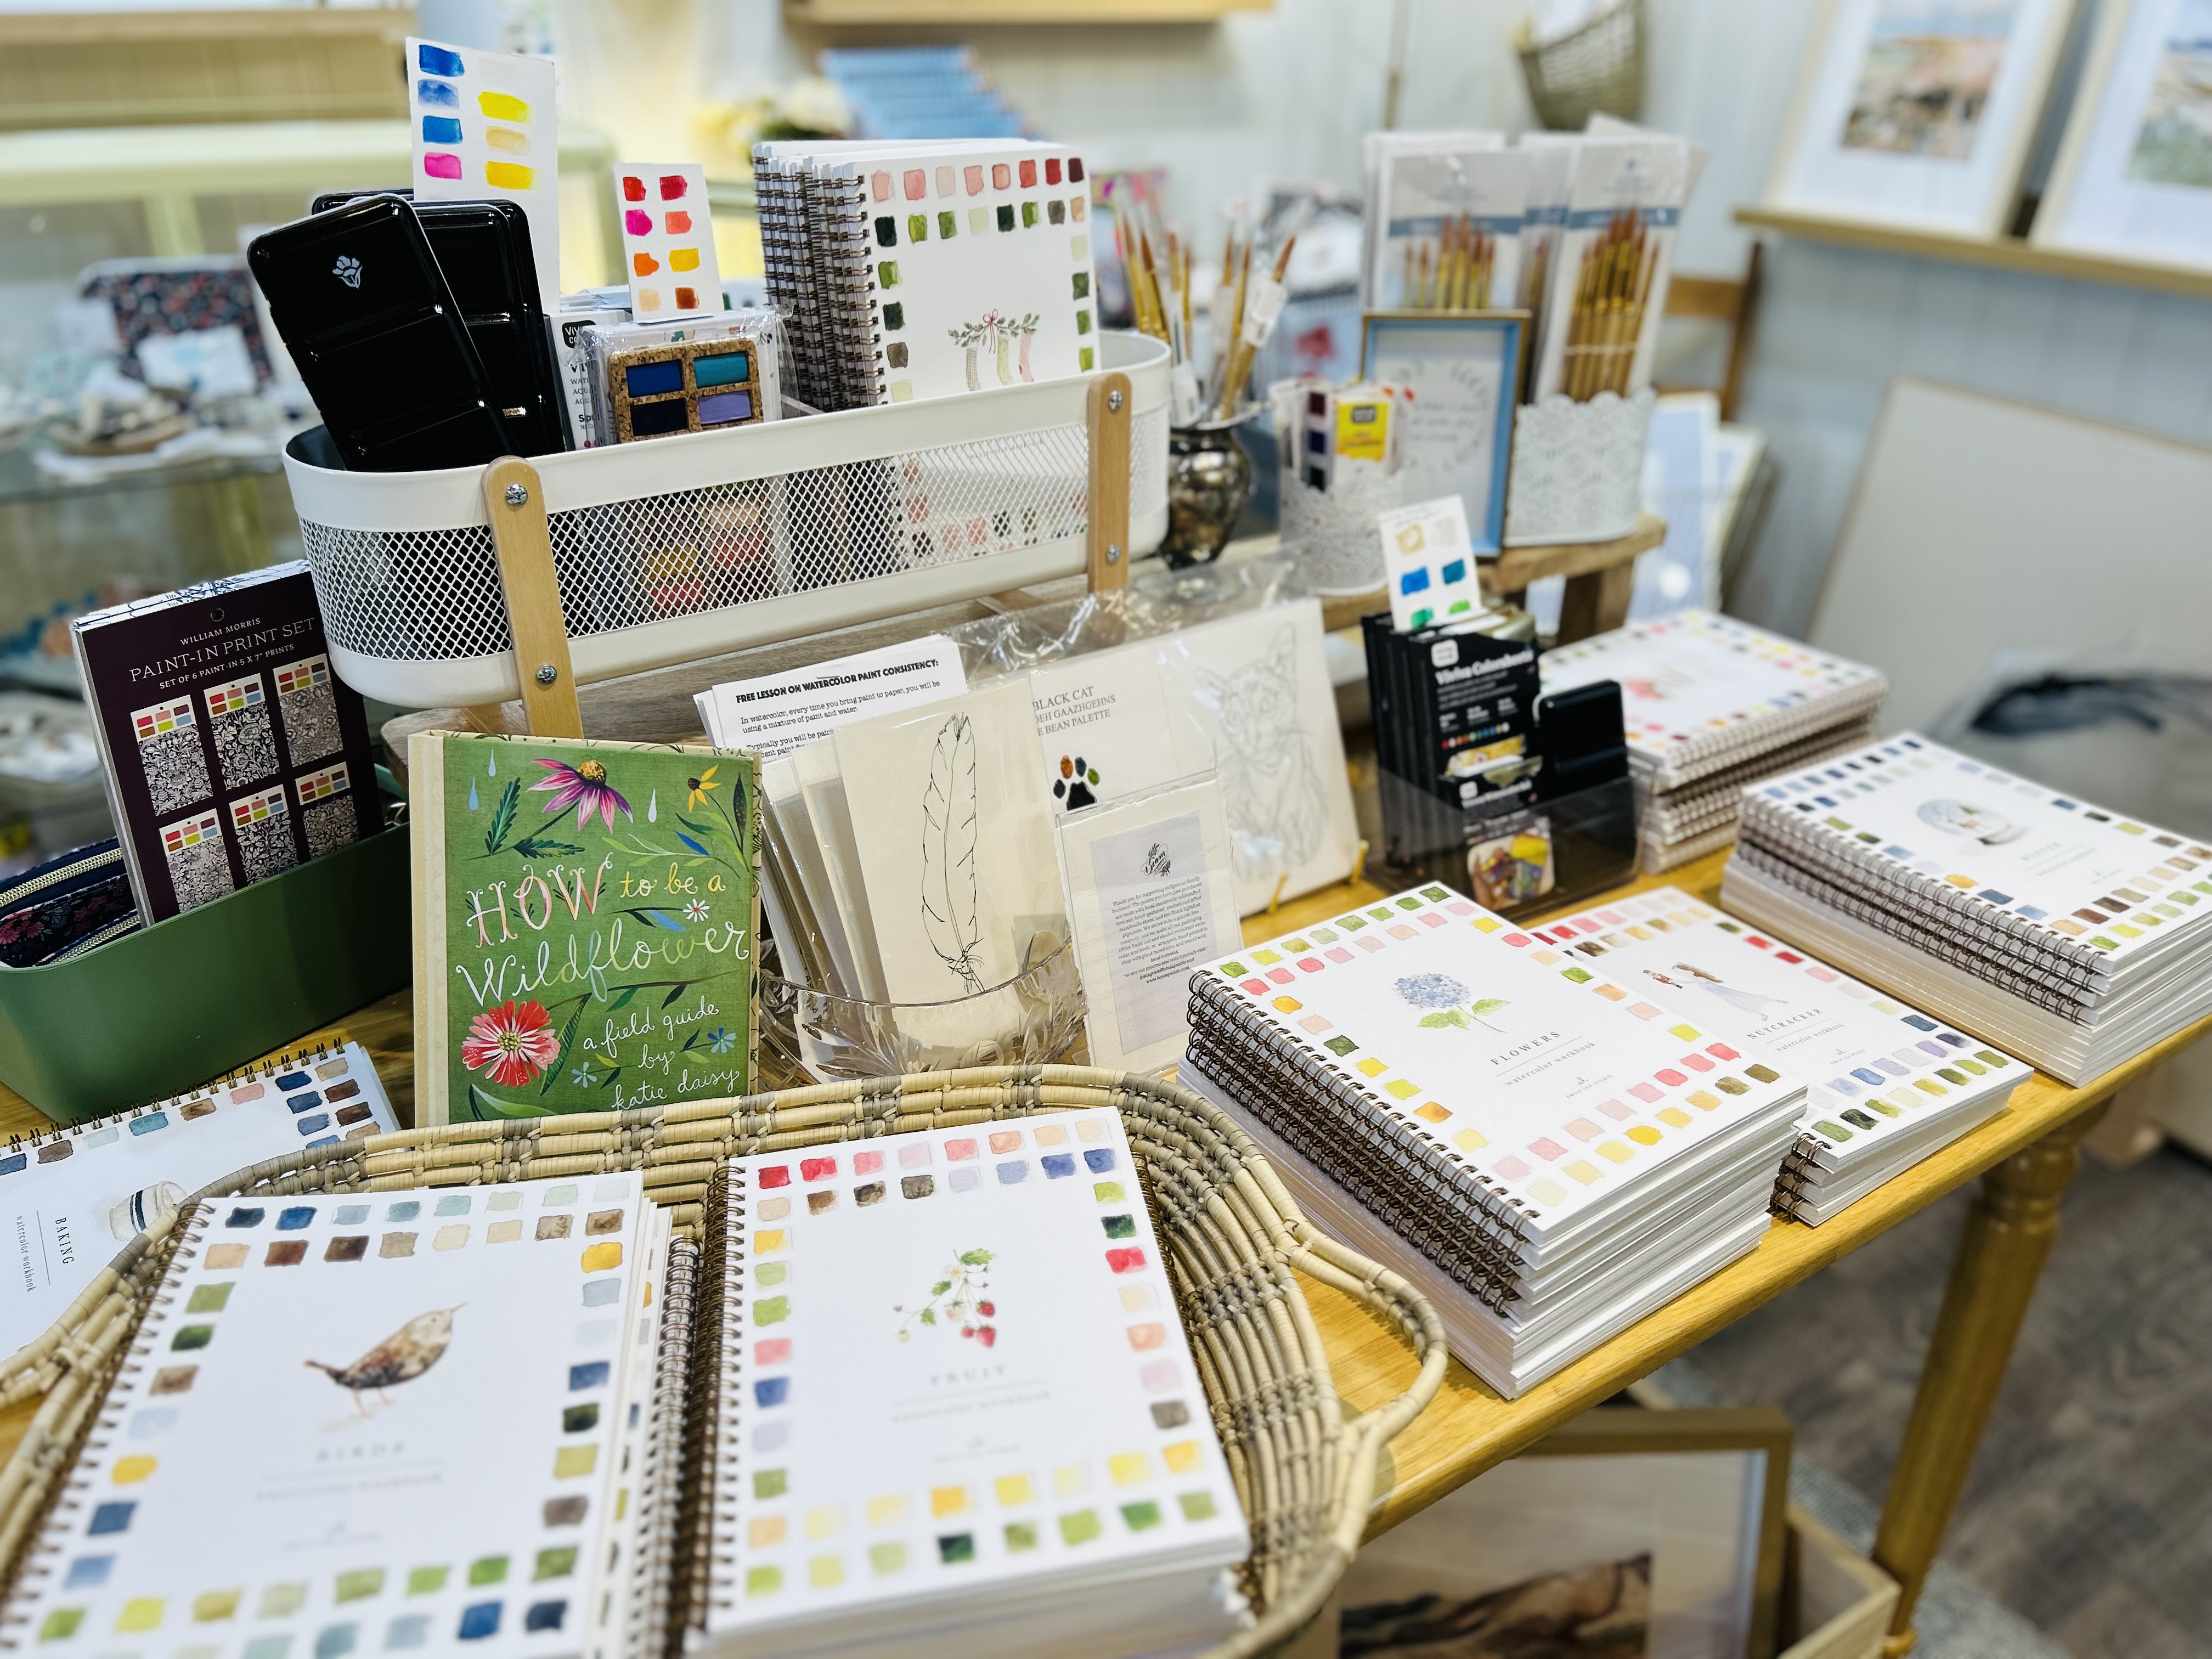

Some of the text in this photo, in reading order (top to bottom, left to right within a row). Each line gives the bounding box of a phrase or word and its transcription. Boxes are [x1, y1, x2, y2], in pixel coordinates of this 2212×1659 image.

[129, 617, 314, 682] PAINT-IN PRINT SET
[180, 618, 261, 645] WILLIAM MORRIS
[159, 679, 176, 689] SET
[178, 674, 190, 683] OF
[199, 660, 238, 677] PAINT-IN
[255, 653, 263, 661] 7"
[265, 644, 294, 658] PRINTS
[736, 659, 939, 703] FREE LESSON ON WATERCOLOR PAINT CONSISTENCY:
[749, 711, 788, 723] watercolor,
[789, 707, 808, 715] every
[826, 701, 839, 709] you
[839, 697, 858, 706] bring
[857, 693, 876, 703] paint
[884, 689, 905, 698] paper,
[905, 685, 921, 694] you
[919, 681, 932, 690] will
[1032, 686, 1093, 710] BLACK CAT
[1053, 695, 1116, 718] GAAZHGEHNS
[742, 724, 763, 733] using
[768, 719, 796, 729] mixture
[805, 713, 823, 723] paint
[824, 709, 837, 718] and
[779, 737, 793, 746] you
[793, 733, 807, 742] will
[1044, 719, 1070, 734] BEAN
[1071, 708, 1111, 727] PALETTE
[466, 851, 726, 949] HOW to be a
[455, 917, 749, 1007] Wildflower
[583, 996, 720, 1059] a field guide
[1747, 1008, 1823, 1040] NUTCRACKER
[637, 1045, 676, 1076] by
[1490, 1031, 1561, 1065] FLOWERS
[1505, 1061, 1554, 1087] watercolor
[1555, 1042, 1596, 1063] workbook
[611, 1068, 741, 1112] katie daisy
[16, 1215, 36, 1292] watercolor workbook
[55, 1217, 74, 1264] BAKING
